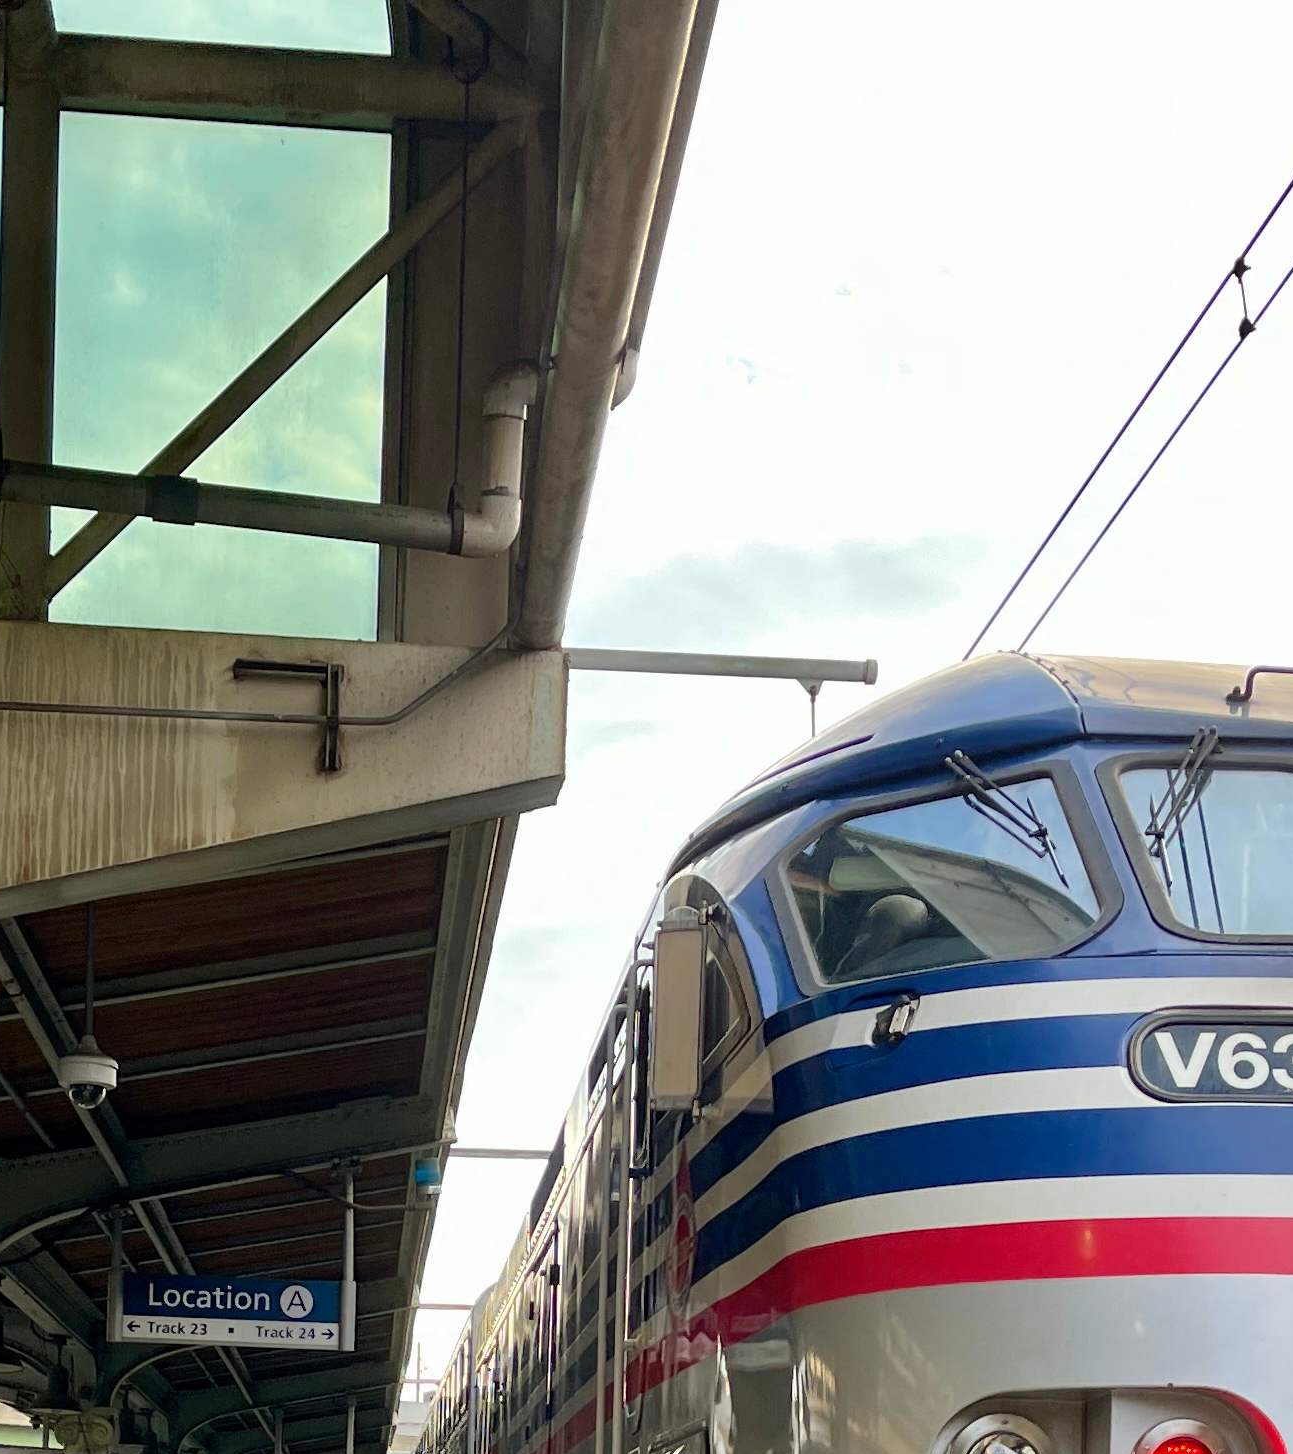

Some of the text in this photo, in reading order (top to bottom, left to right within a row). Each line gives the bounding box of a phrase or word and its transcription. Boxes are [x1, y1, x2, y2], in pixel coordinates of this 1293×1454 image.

[148, 1282, 307, 1311] Location A
[147, 1321, 208, 1336] Track 23
[256, 1325, 316, 1340] Track 24
